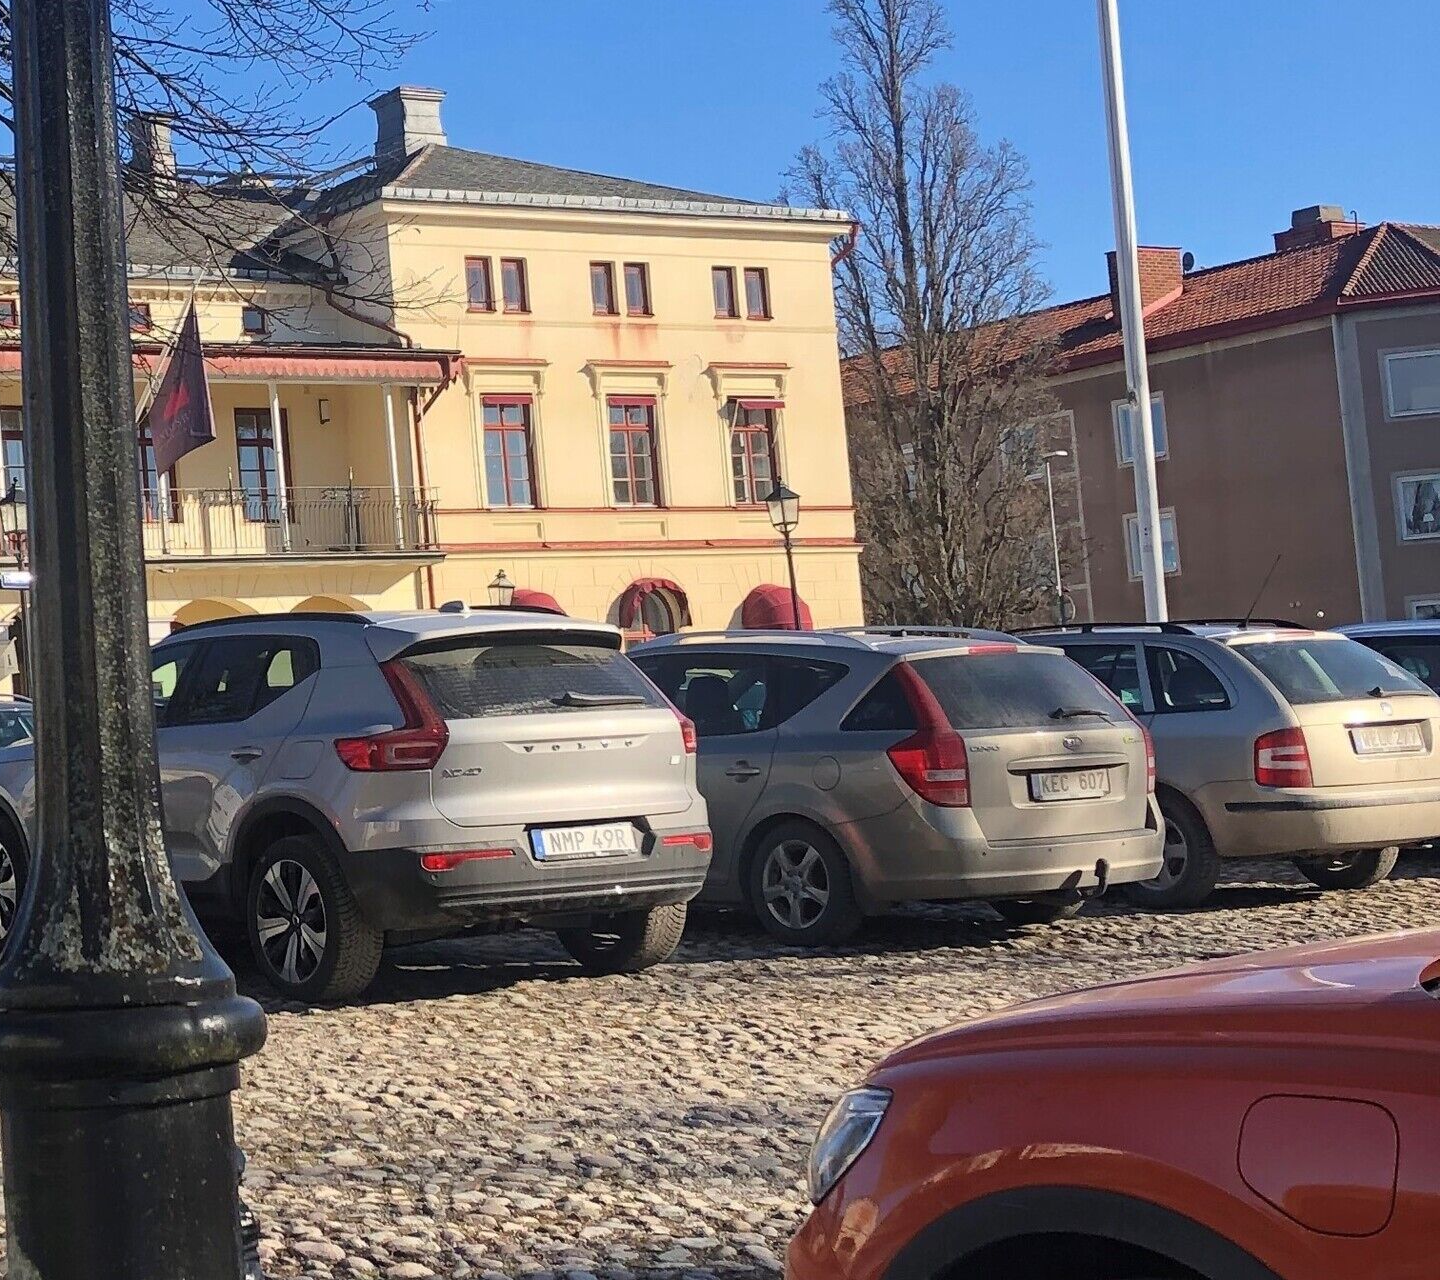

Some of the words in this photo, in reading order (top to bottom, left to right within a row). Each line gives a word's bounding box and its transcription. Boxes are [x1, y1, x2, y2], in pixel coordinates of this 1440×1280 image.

[1042, 776, 1070, 794] KEC
[1079, 772, 1104, 791] 607
[549, 831, 585, 852] NMP
[592, 829, 626, 849] 49R
